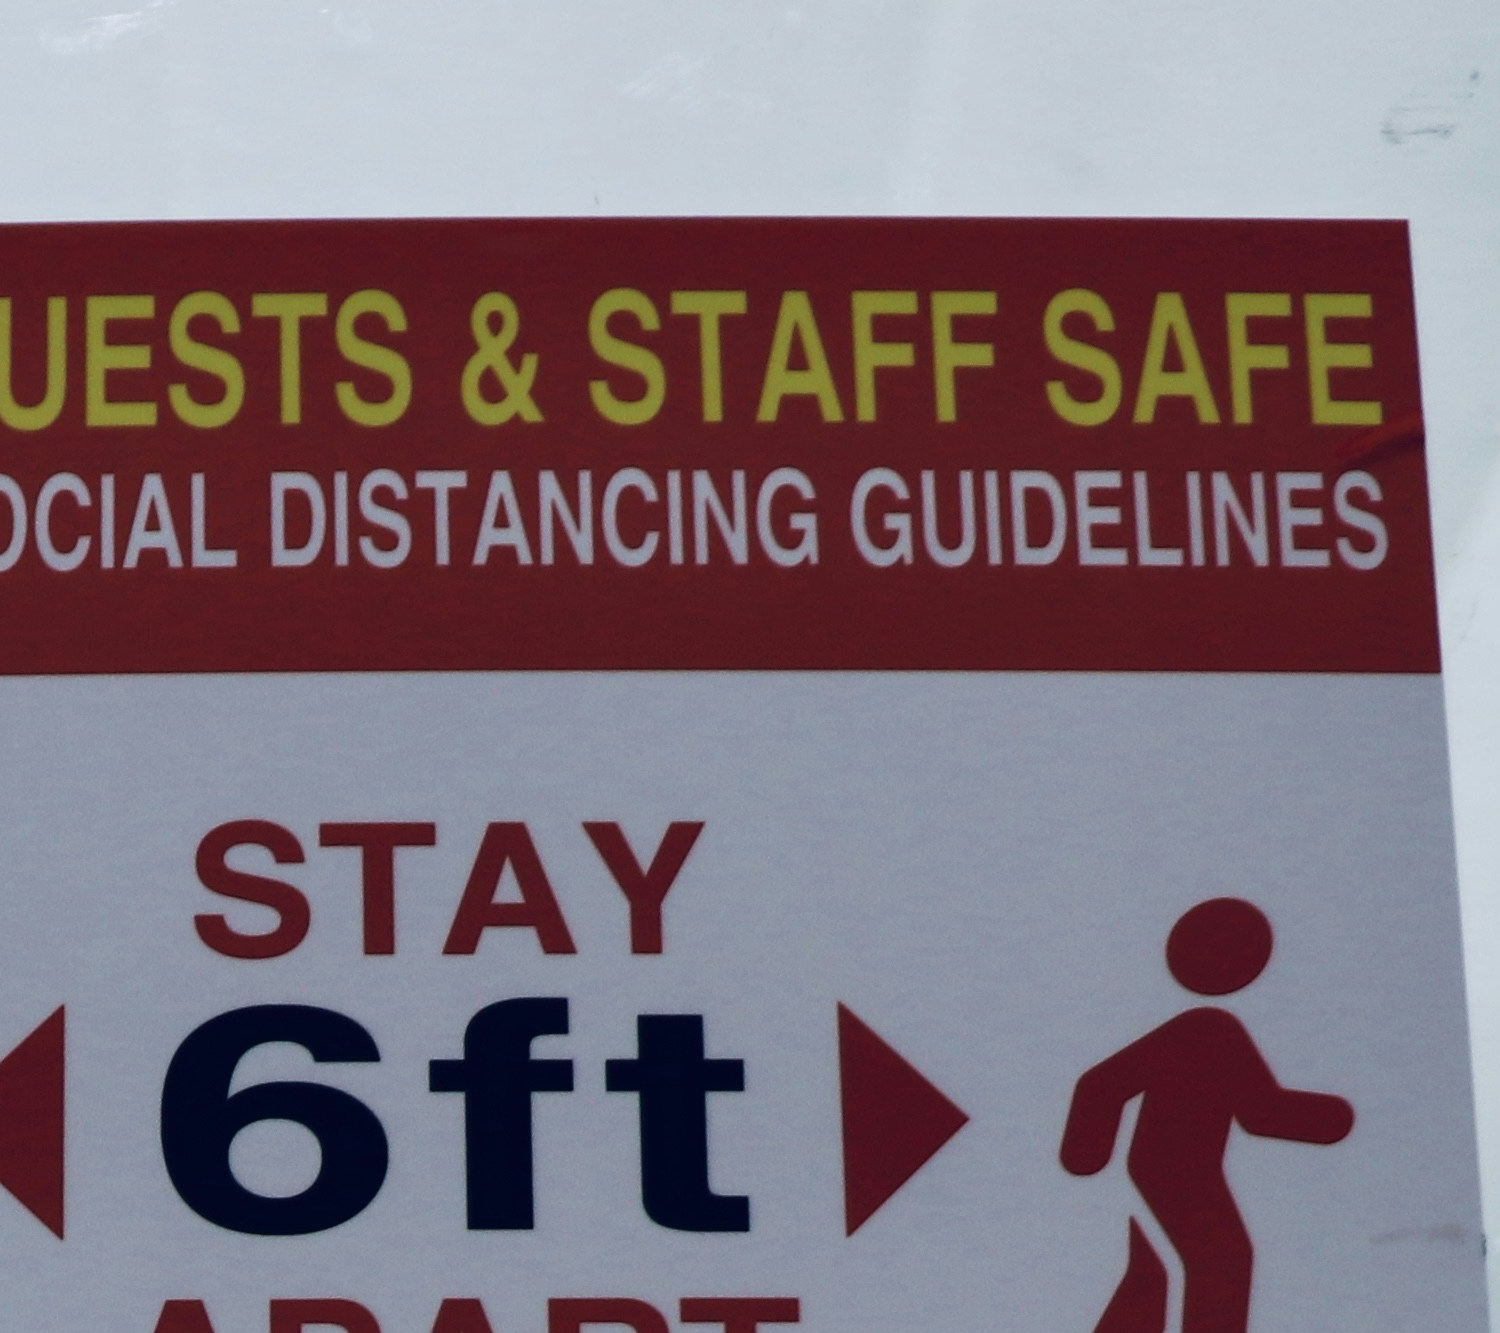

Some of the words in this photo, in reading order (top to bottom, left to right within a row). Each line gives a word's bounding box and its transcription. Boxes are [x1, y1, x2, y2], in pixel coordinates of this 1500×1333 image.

[464, 294, 541, 424] &
[591, 291, 995, 424] STAFF
[1046, 291, 1379, 424] SAFE
[271, 468, 818, 568] DISTANCING
[851, 468, 1387, 569] GUIDELINES
[194, 819, 705, 960] STAY
[160, 996, 751, 1237] 6ft
